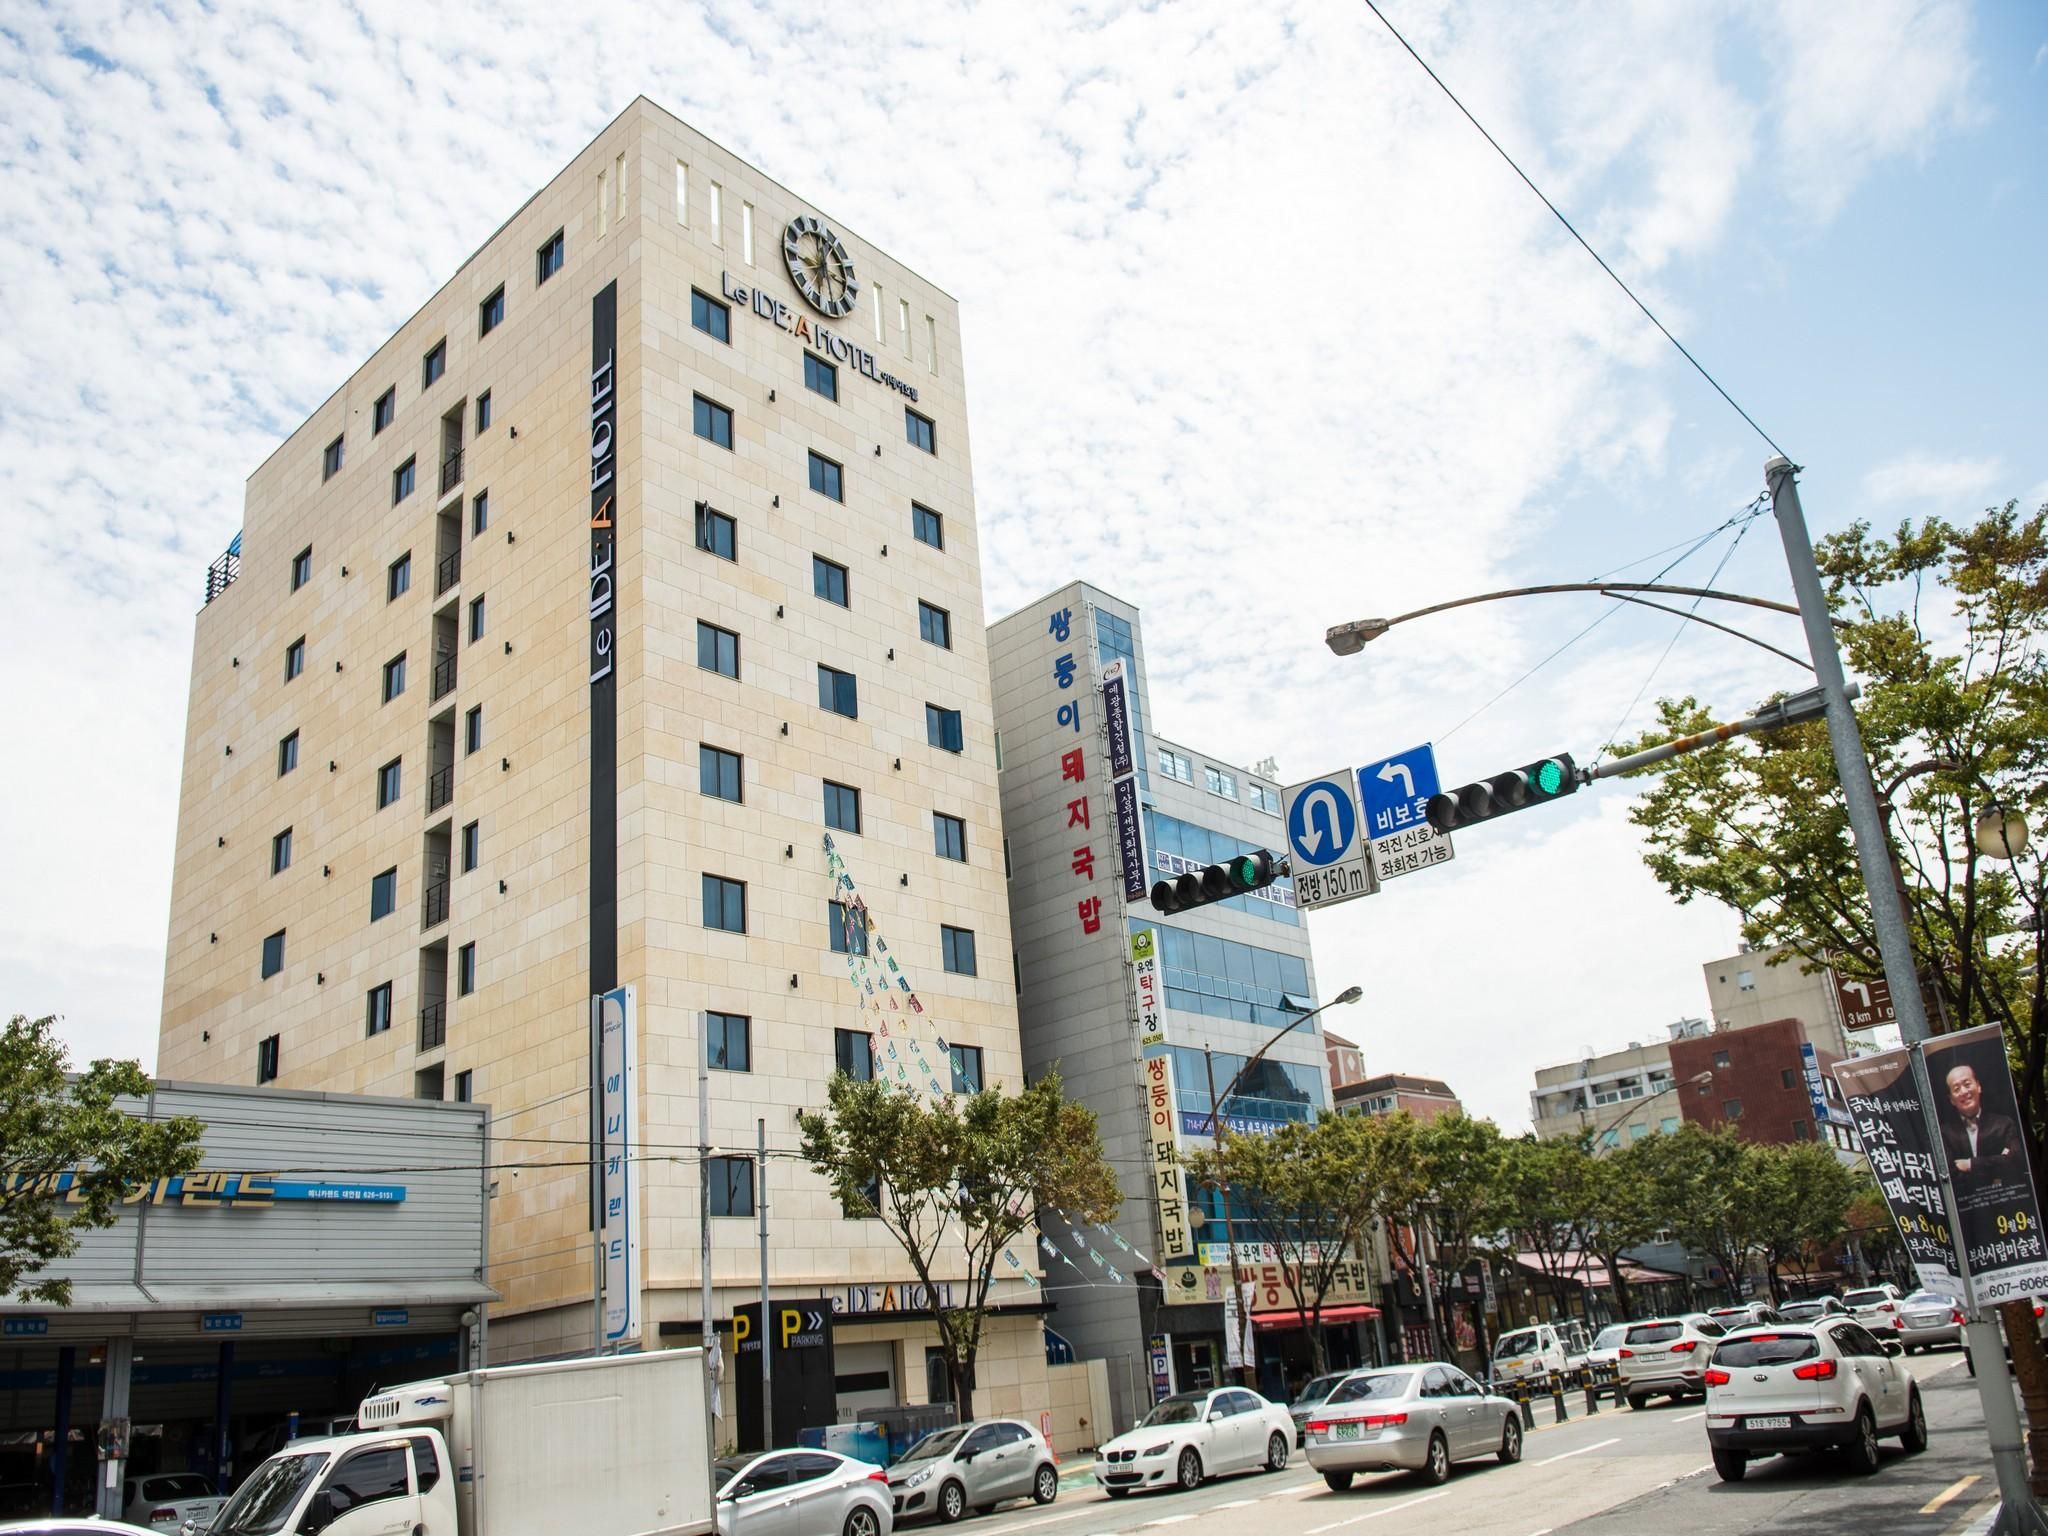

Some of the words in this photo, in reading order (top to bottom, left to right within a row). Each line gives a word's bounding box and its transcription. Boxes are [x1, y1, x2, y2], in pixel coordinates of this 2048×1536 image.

[722, 271, 749, 306] Le
[816, 324, 882, 384] HOTEL
[591, 348, 613, 493] HOTEL
[590, 627, 613, 685] Le
[1376, 796, 1429, 830] 비보호
[1061, 747, 1102, 935] 돼지국밥
[1378, 835, 1404, 855] 직진
[1381, 853, 1420, 877] 좌회전
[1420, 844, 1448, 864] 가능
[1298, 873, 1322, 904] 전방
[1136, 959, 1154, 974] 유엔
[1139, 975, 1158, 1032] 탁구장
[1147, 1058, 1172, 1132] 쌍둥이
[1859, 1117, 1898, 1145] 부산
[606, 1073, 624, 1260] 애니카랜드
[1156, 1140, 1184, 1254] 돼지국밥
[1242, 1244, 1261, 1263] 유엔
[1262, 1243, 1292, 1262] 탁장
[1969, 1235, 2041, 1269] 부산시립미술관
[781, 1309, 801, 1349] P
[791, 1334, 824, 1346] PARKING
